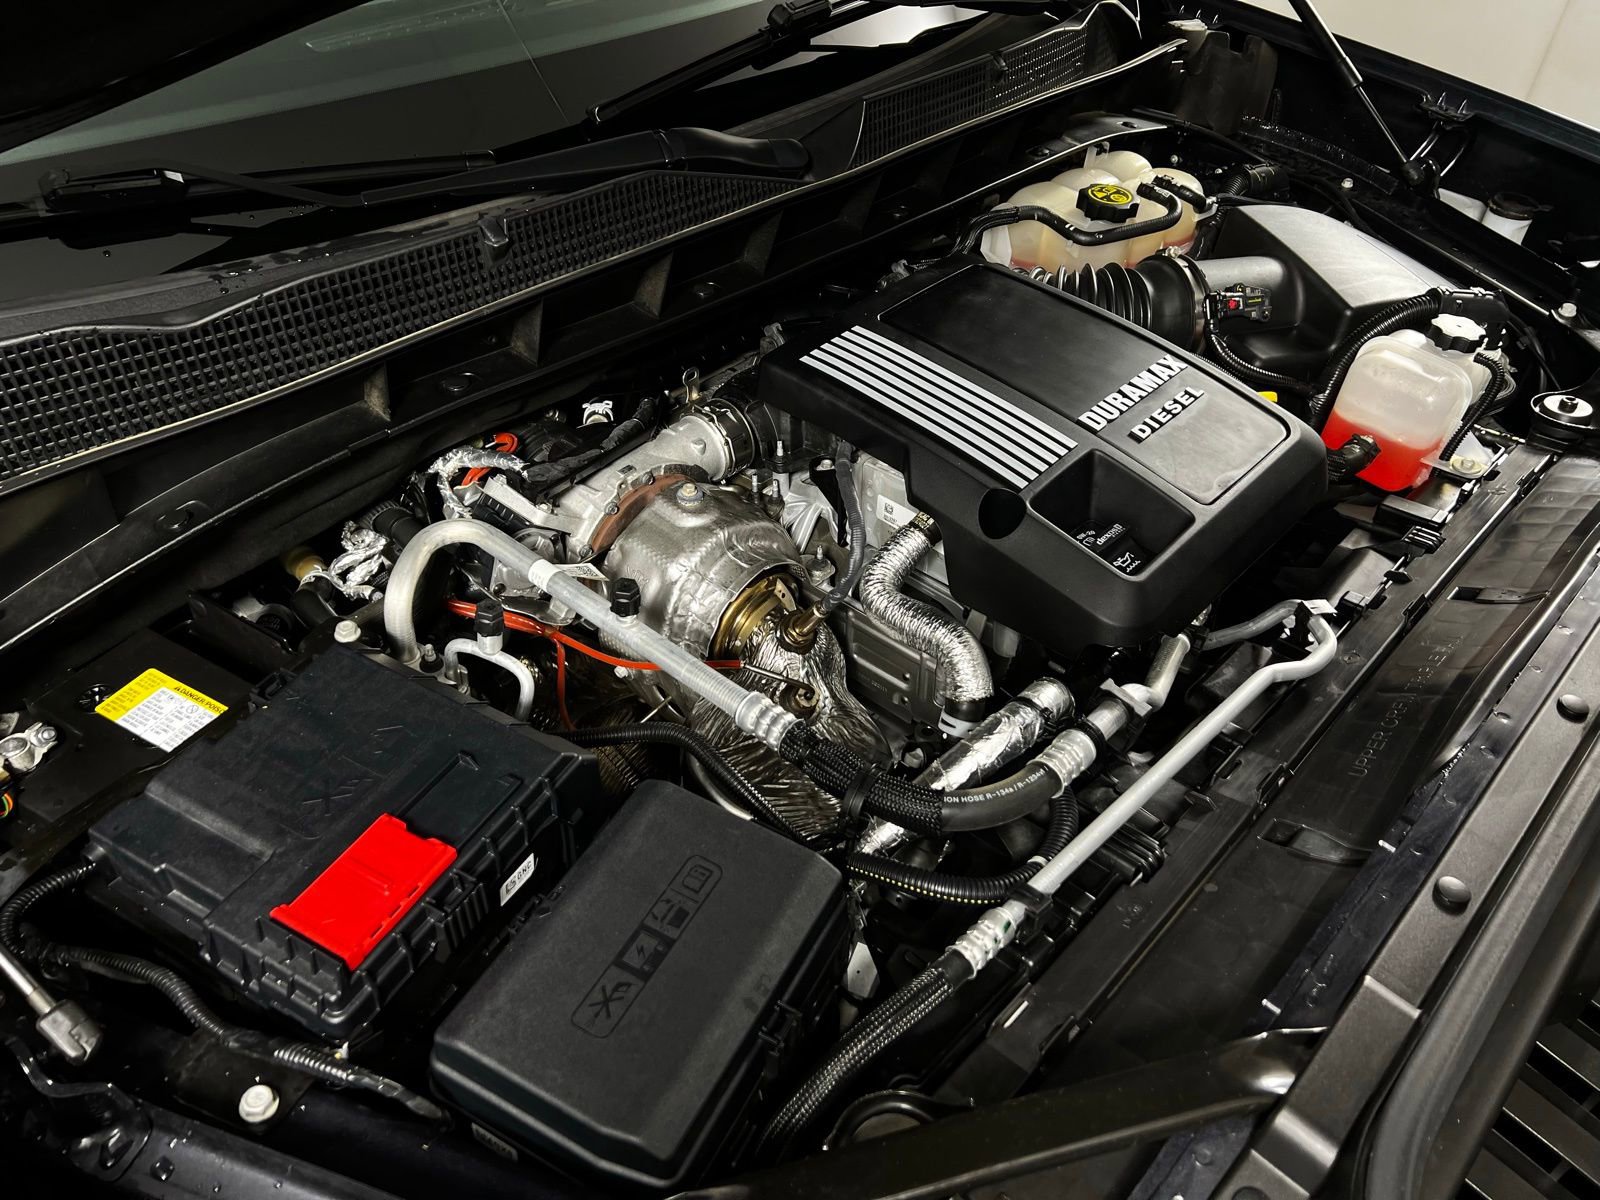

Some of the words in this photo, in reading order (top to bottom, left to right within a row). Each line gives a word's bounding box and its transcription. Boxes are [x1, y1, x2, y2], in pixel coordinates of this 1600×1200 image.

[1078, 354, 1188, 431] DURAMAX
[1130, 386, 1205, 440] DIESEL
[1348, 731, 1392, 777] UPPER
[961, 794, 985, 803] HOSE
